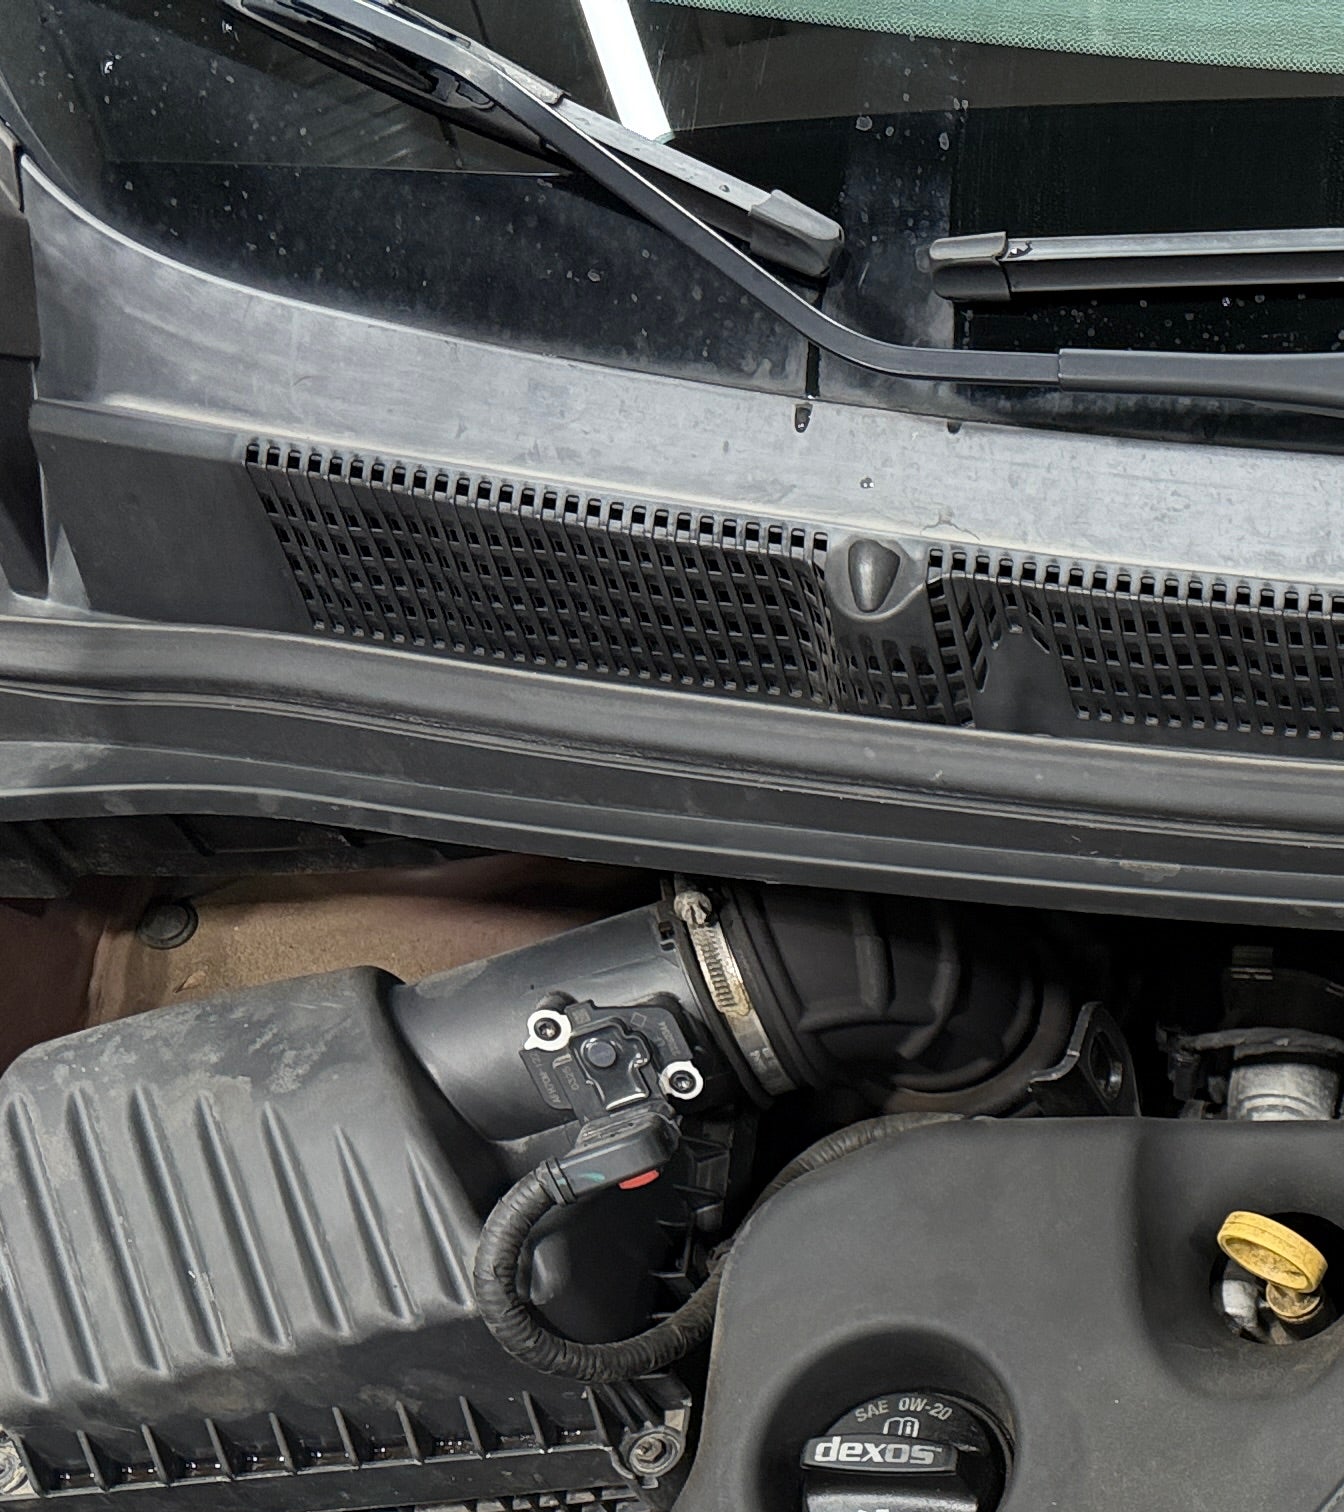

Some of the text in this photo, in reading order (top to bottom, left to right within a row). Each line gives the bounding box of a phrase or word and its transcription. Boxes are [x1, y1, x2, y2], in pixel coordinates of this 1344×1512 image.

[855, 1396, 953, 1423] SAE 0W-20
[814, 1435, 942, 1464] dexos
